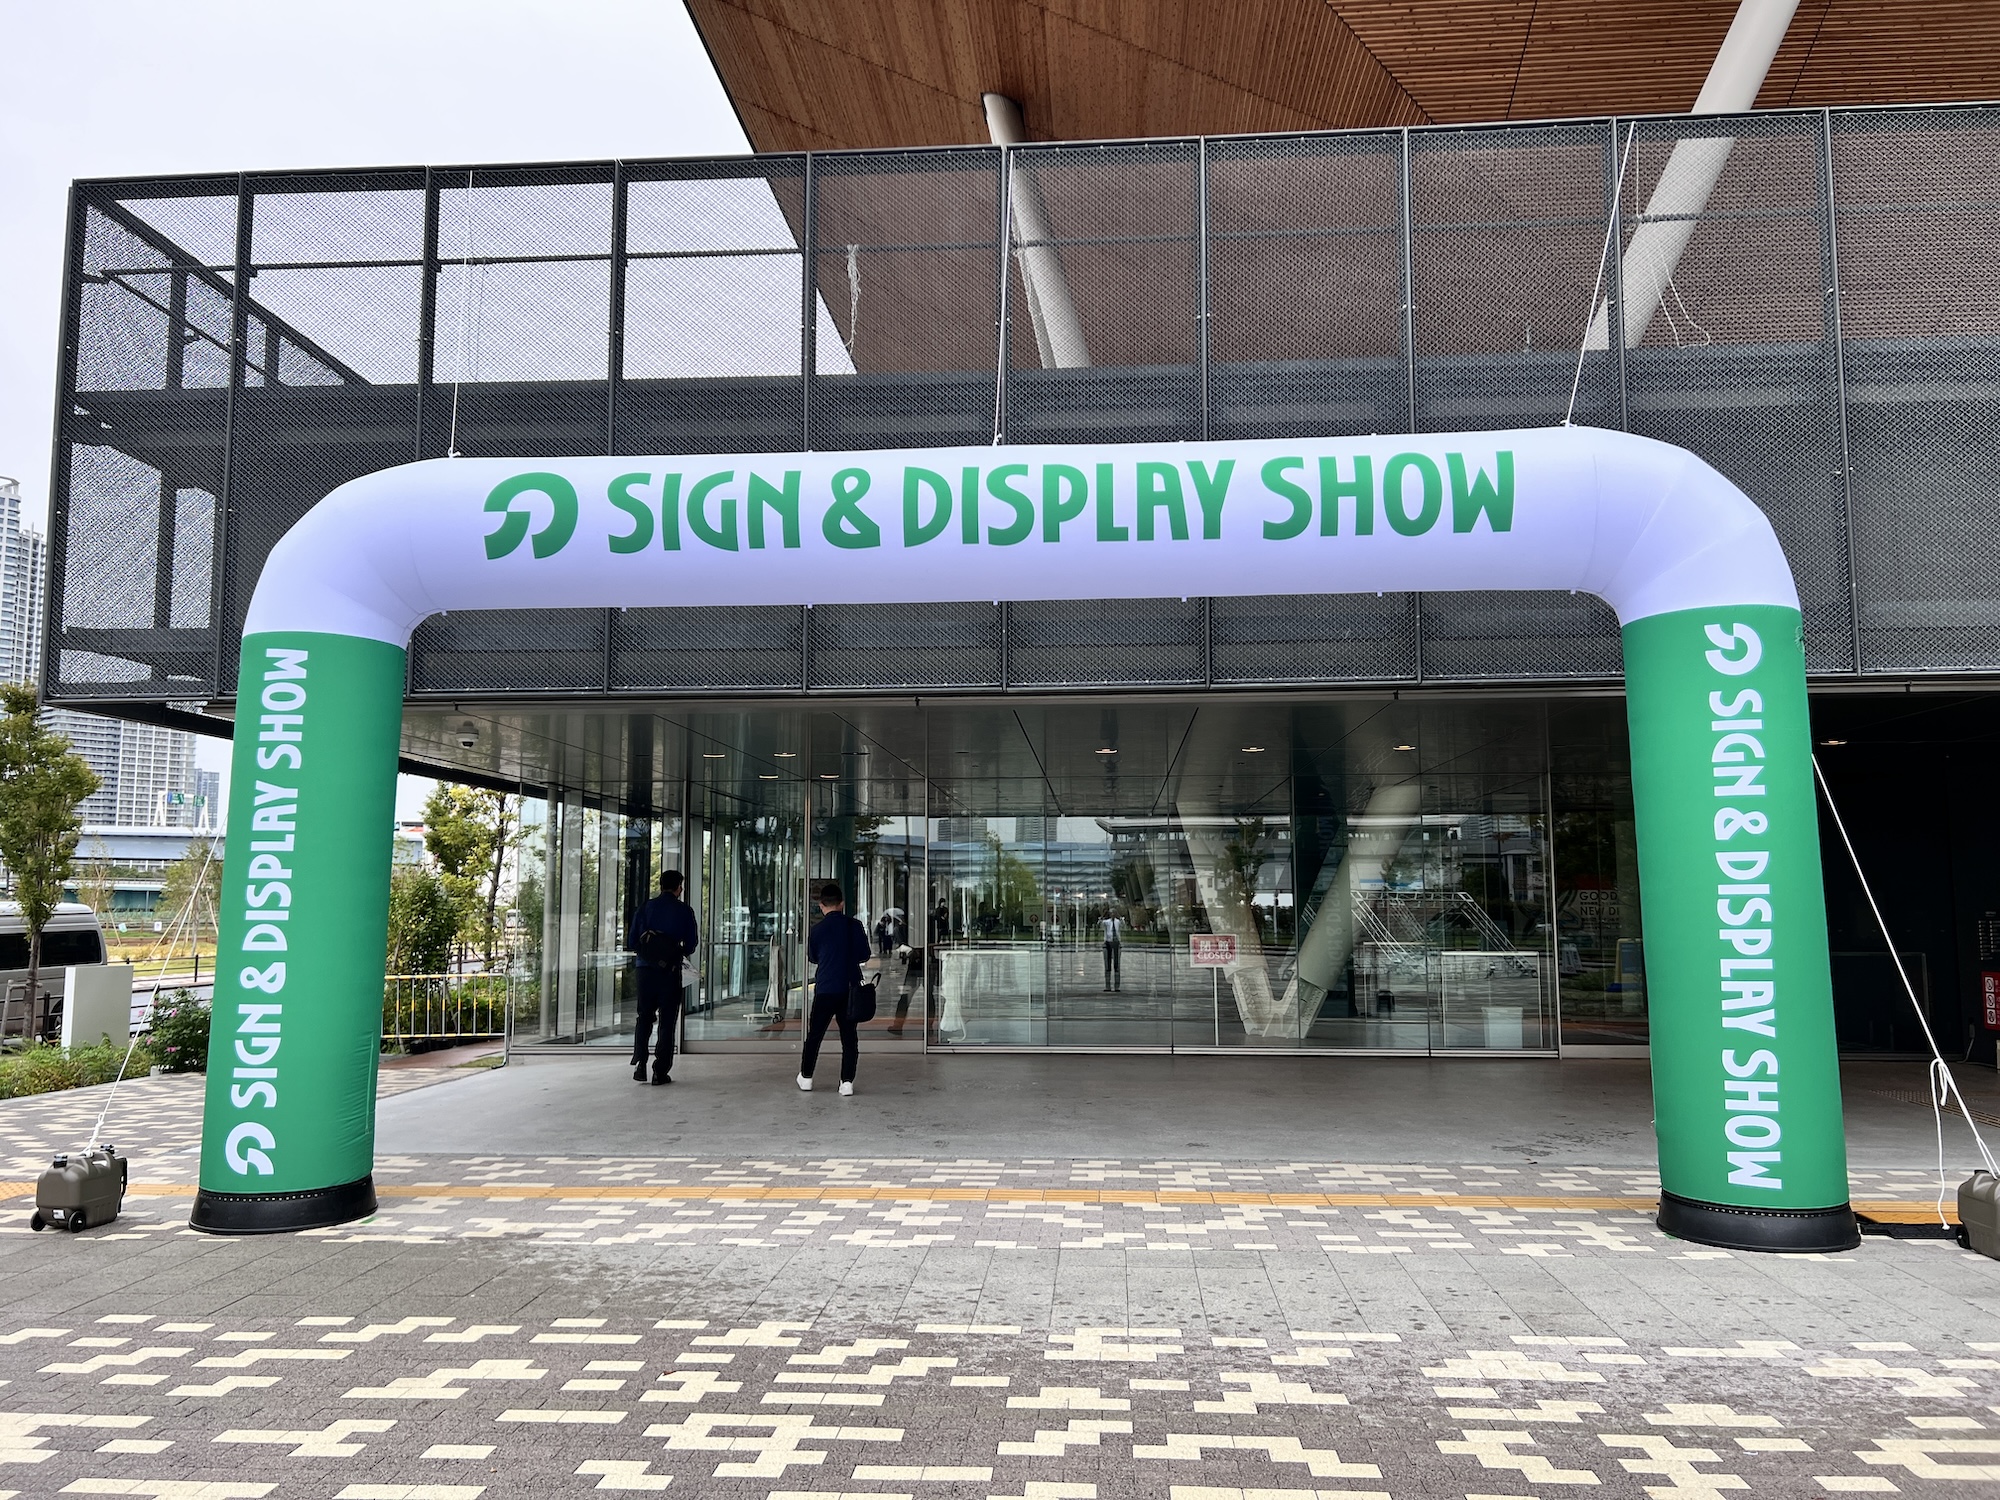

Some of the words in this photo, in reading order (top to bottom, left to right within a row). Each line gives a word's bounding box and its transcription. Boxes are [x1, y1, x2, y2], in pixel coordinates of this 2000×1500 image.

[607, 470, 801, 553] SIGN
[822, 467, 881, 549] &
[903, 459, 1236, 546] DISPLAY
[1260, 450, 1515, 540] SHOW
[256, 648, 309, 770] SHOW
[1708, 688, 1767, 797] SIGN
[242, 779, 299, 951] DISPLAY
[1713, 807, 1769, 841] &
[1579, 891, 1618, 901] GOOD
[1715, 851, 1776, 1038] DISPLAY
[239, 961, 287, 994] &
[1197, 951, 1232, 960] CLOSED
[227, 1003, 278, 1109] SIGN
[1721, 1049, 1783, 1190] SHOW
